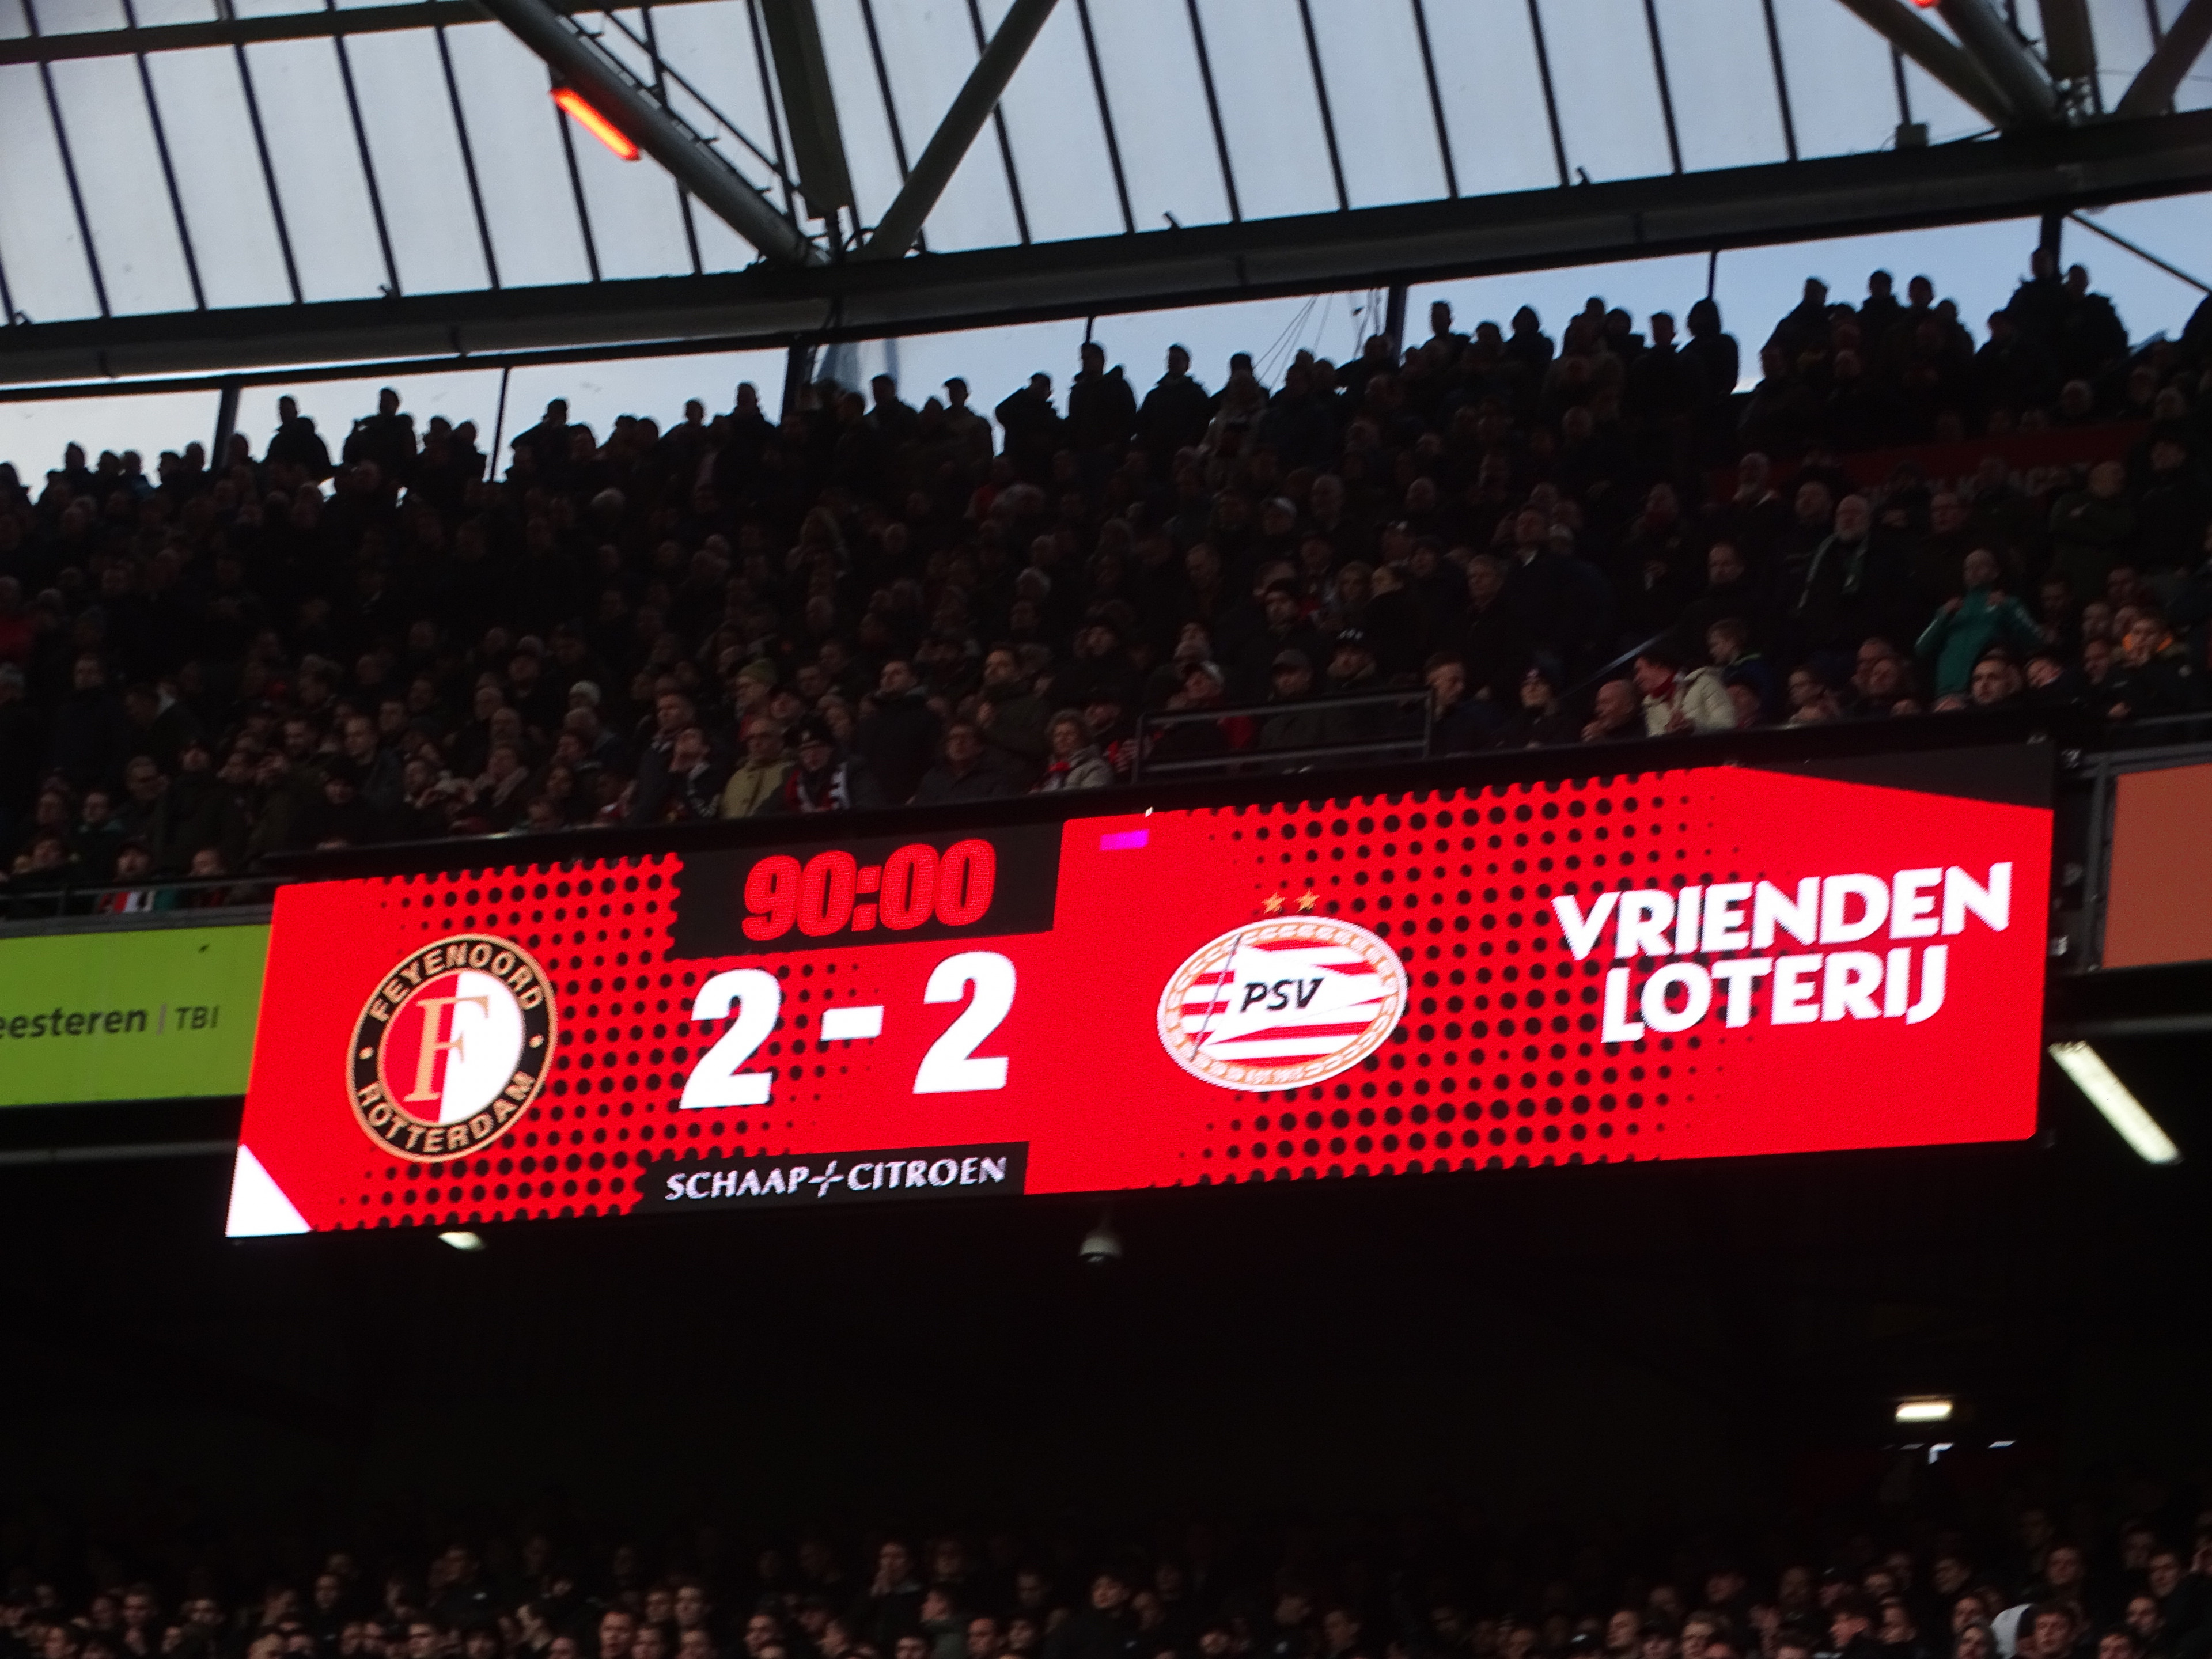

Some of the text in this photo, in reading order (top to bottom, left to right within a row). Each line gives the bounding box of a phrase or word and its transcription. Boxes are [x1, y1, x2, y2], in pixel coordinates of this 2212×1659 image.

[741, 838, 997, 941] 90:00
[1551, 862, 2013, 960] VRIENDEN
[0, 1005, 219, 1039] esteren TBI
[368, 942, 544, 1022] FEYENOORD
[1240, 977, 1325, 1013] PSV
[1601, 944, 1948, 1043] LOTERIJ
[403, 995, 489, 1102] F
[680, 968, 781, 1109] 2
[913, 951, 1017, 1094] 2
[358, 1071, 536, 1153] ROTTERDAM
[665, 1166, 809, 1200] SCHAAP
[847, 1156, 1007, 1191] CITROEN
